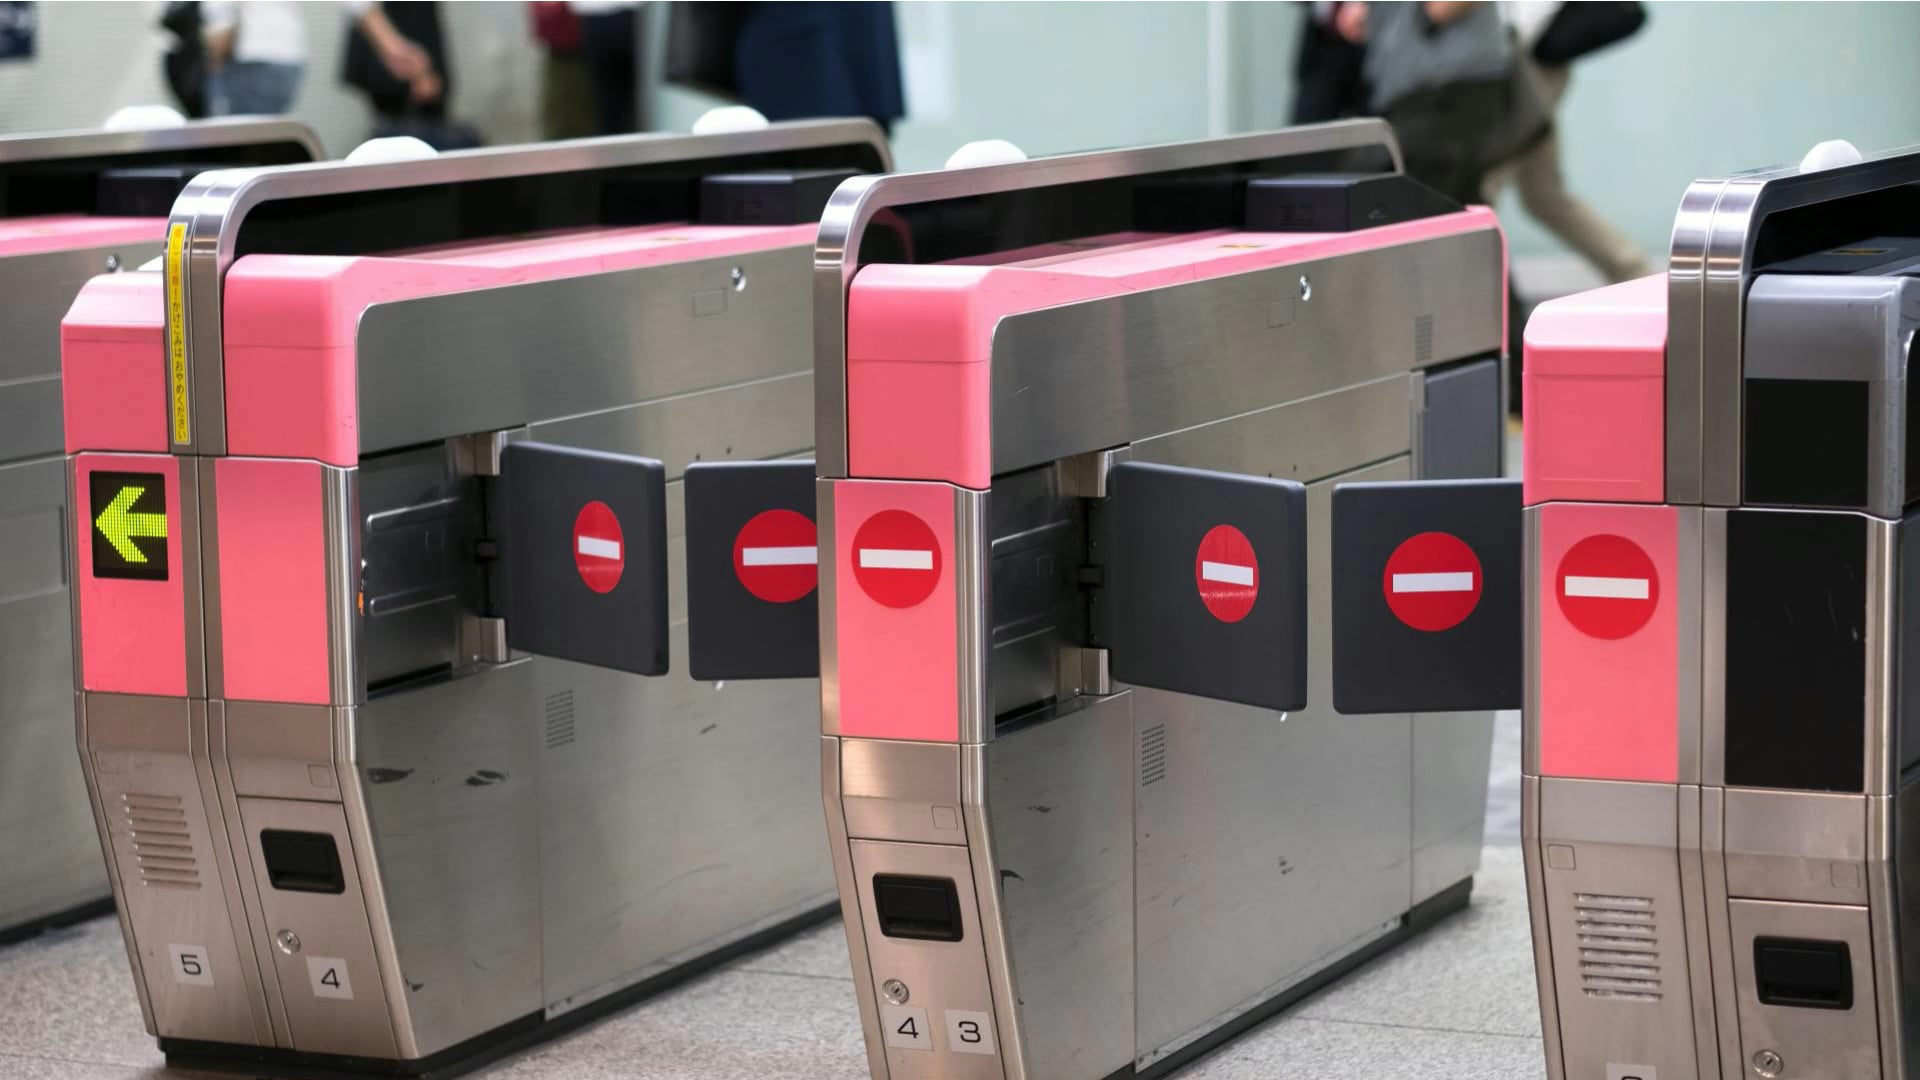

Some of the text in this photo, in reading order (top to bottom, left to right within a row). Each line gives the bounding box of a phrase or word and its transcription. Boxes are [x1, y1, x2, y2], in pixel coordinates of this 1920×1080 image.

[180, 953, 202, 976] 5
[320, 967, 341, 989] 4
[897, 1016, 919, 1039] 4
[958, 1020, 981, 1043] 3
